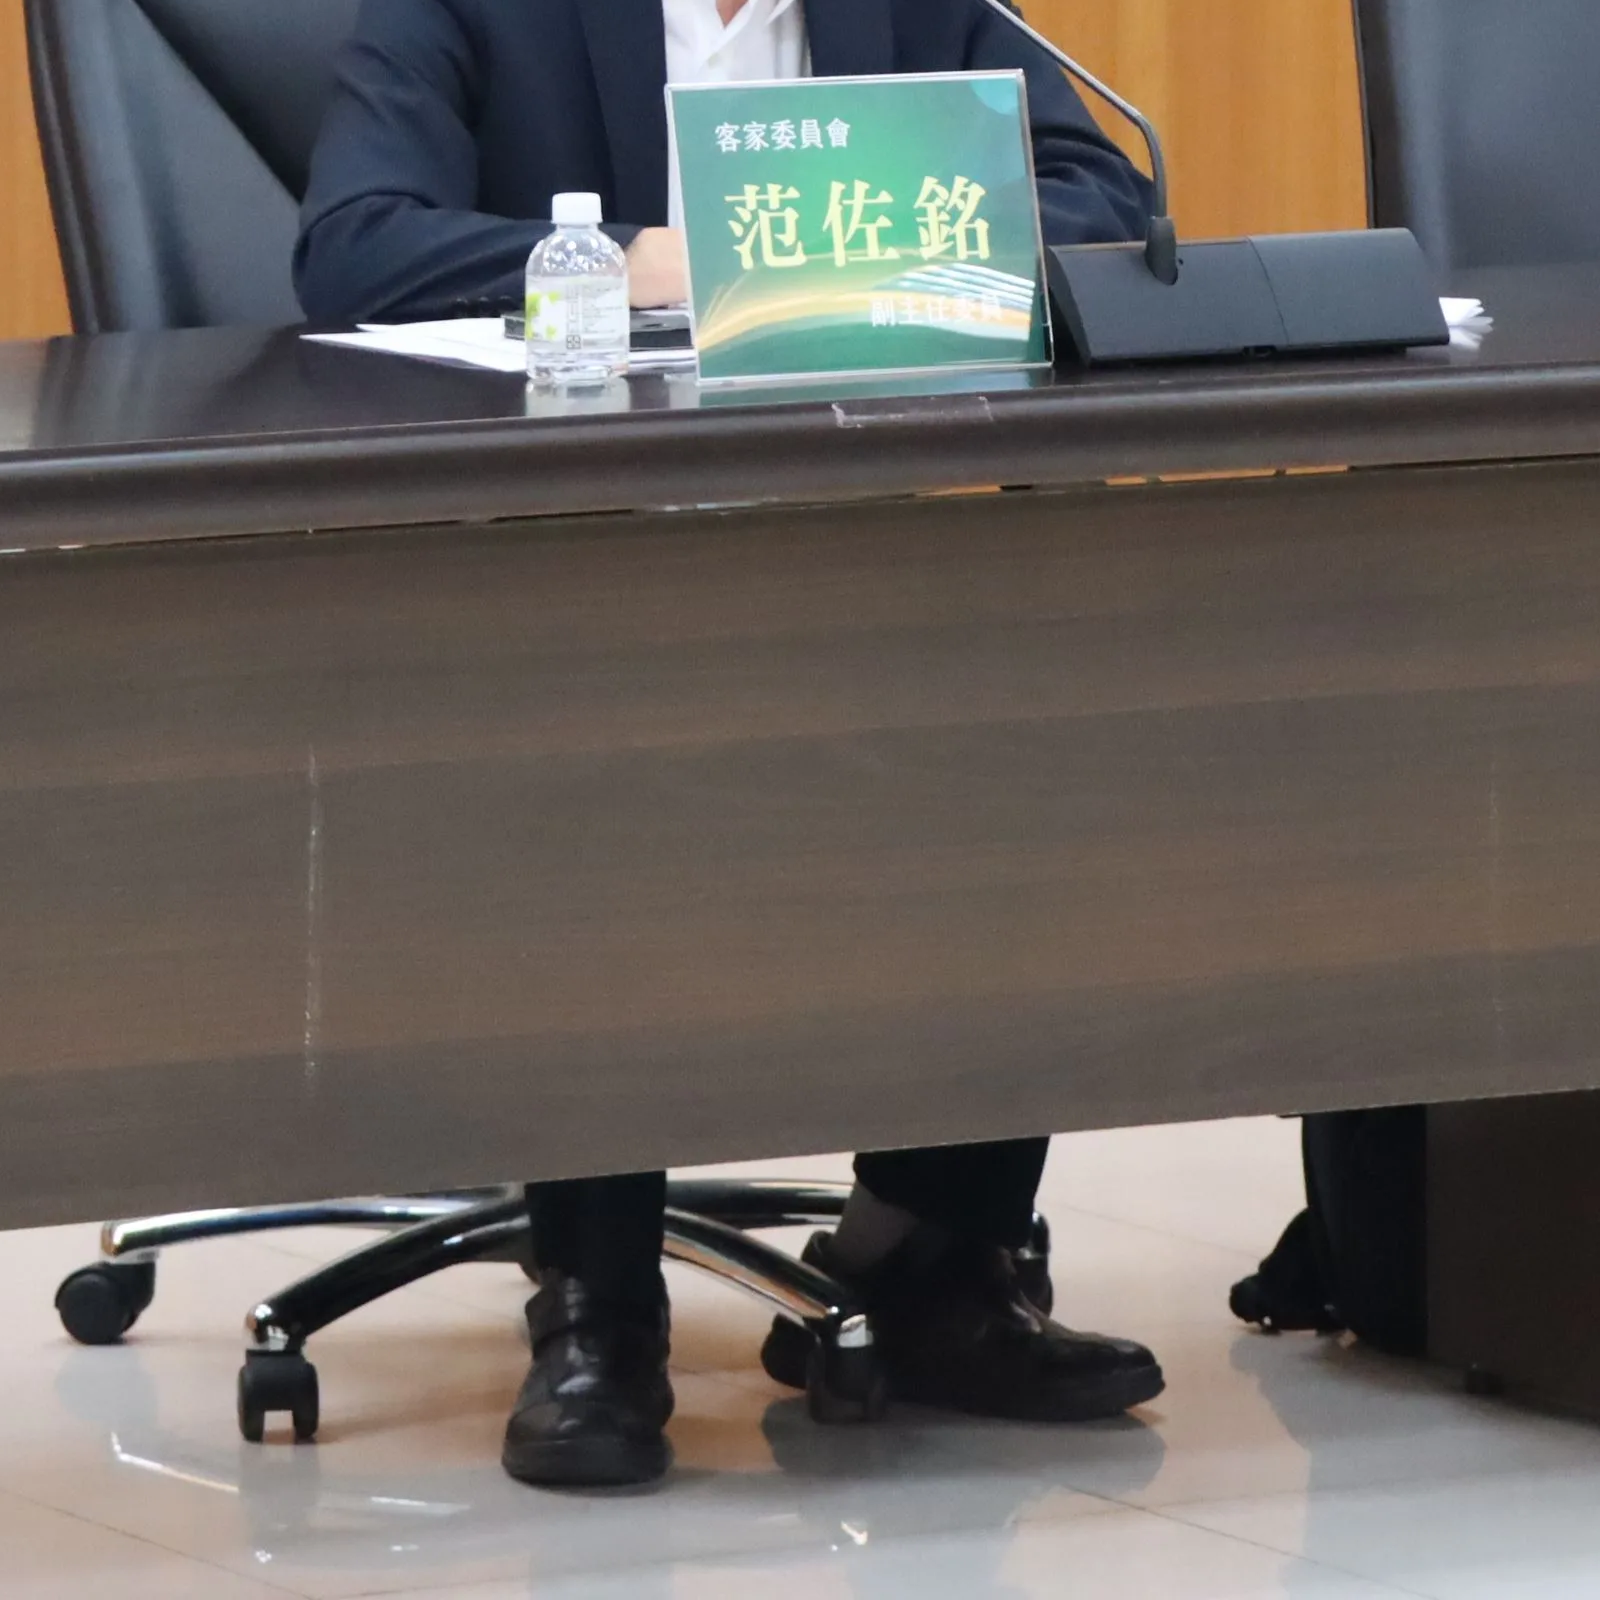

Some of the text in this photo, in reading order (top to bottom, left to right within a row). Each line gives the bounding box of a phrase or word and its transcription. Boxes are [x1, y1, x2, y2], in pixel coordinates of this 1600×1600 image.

[714, 117, 851, 153] 客家委員會
[724, 175, 991, 271] 范佐銘
[870, 294, 1003, 327] 副主任委員
